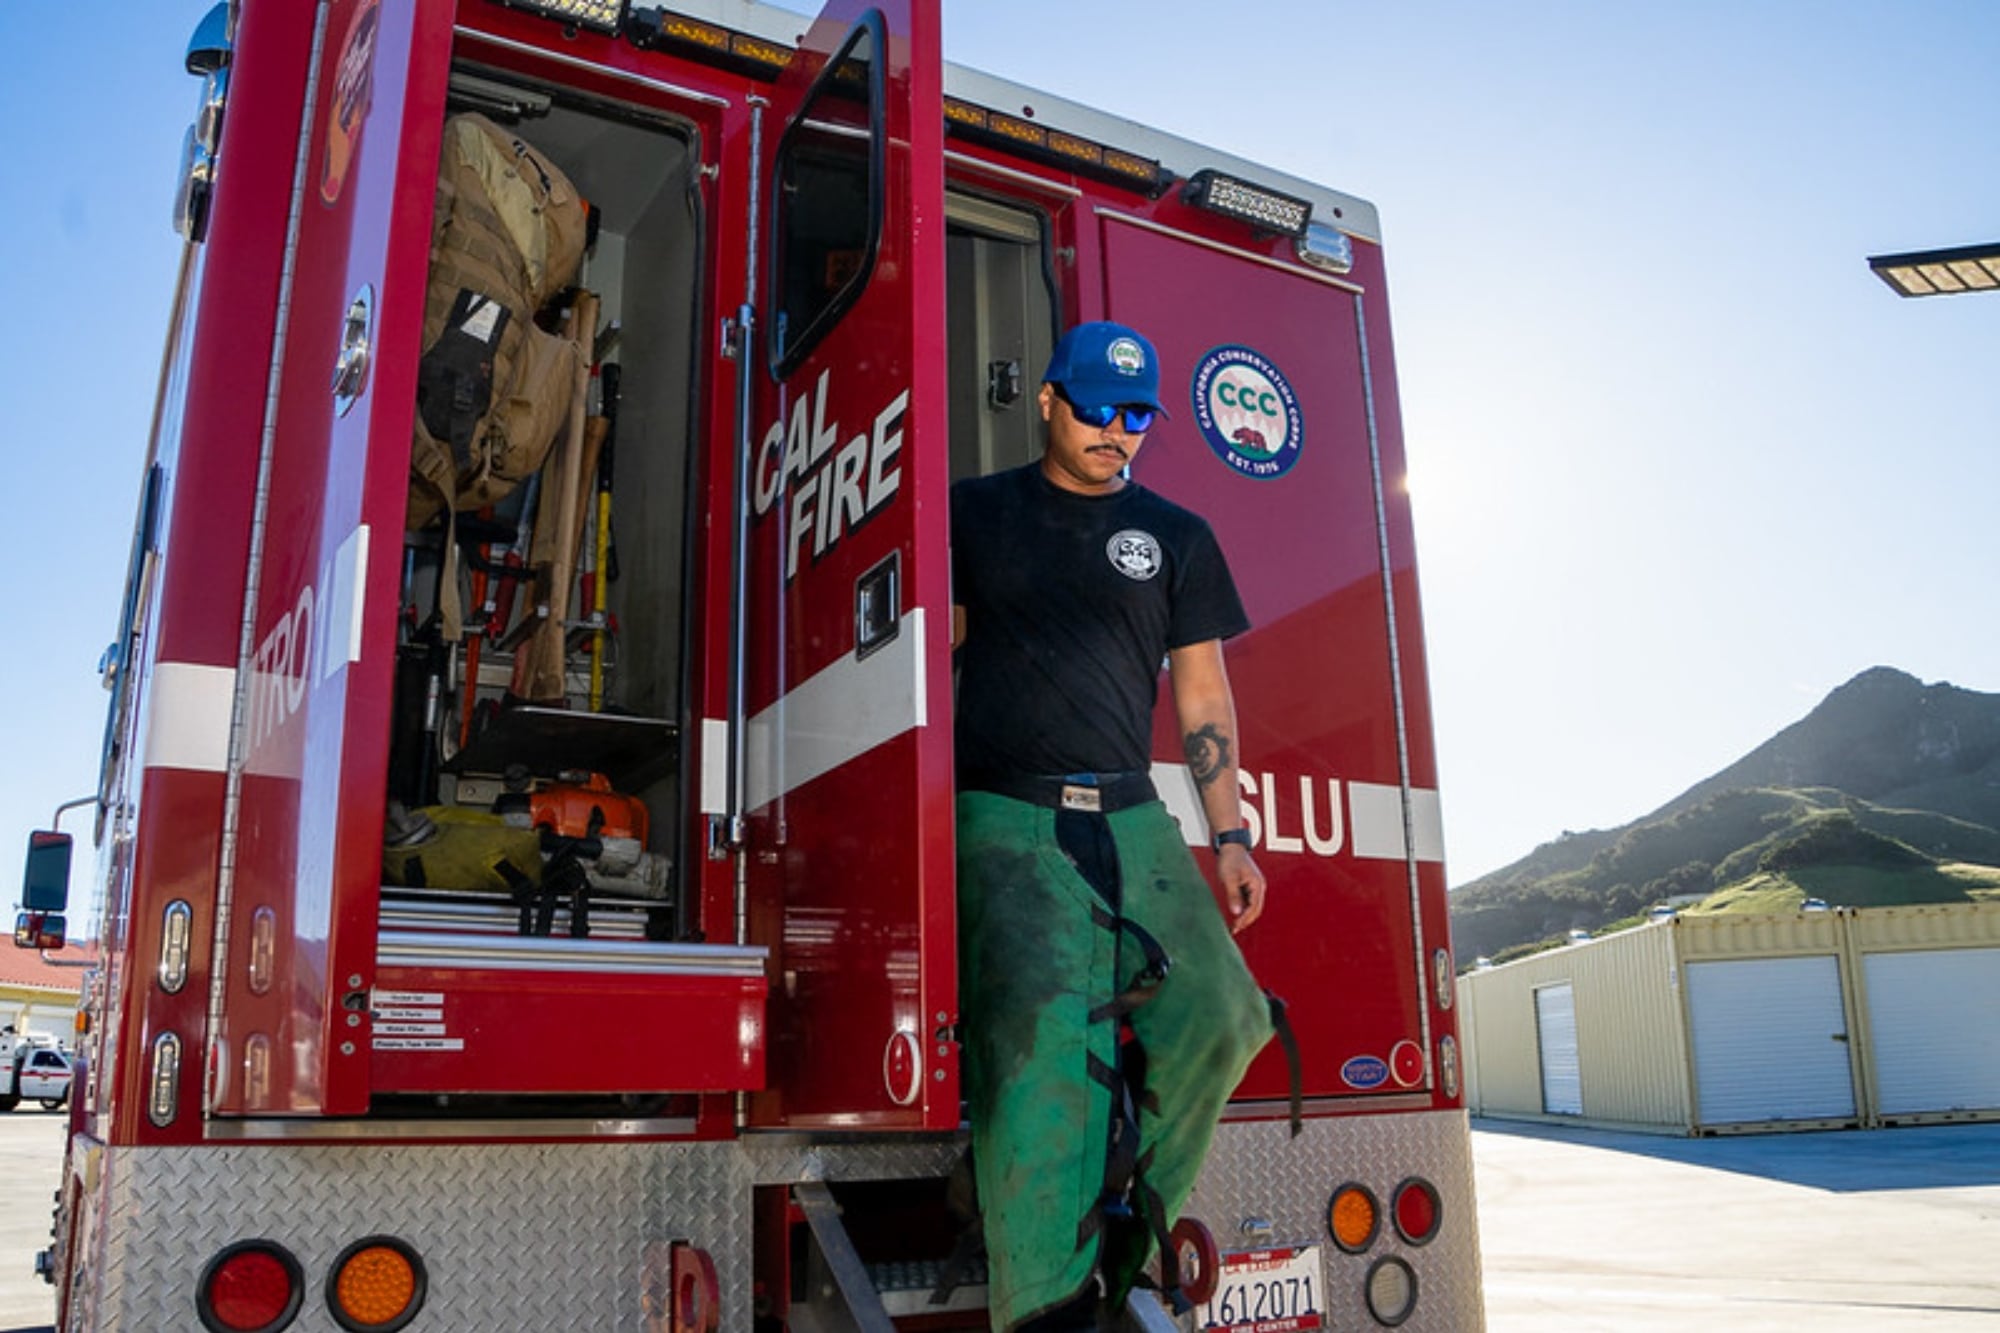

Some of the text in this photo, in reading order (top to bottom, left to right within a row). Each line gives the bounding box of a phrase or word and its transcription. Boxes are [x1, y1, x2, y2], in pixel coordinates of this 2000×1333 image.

[754, 367, 838, 515] CAL
[1196, 350, 1301, 450] CALIFORNIA CONSERVATION CORPS
[1217, 381, 1279, 418] CCC
[786, 387, 910, 579] FIRE
[1237, 767, 1345, 857] SLU
[1204, 1275, 1318, 1328] 1612071
[1256, 1317, 1298, 1332] CENTER
